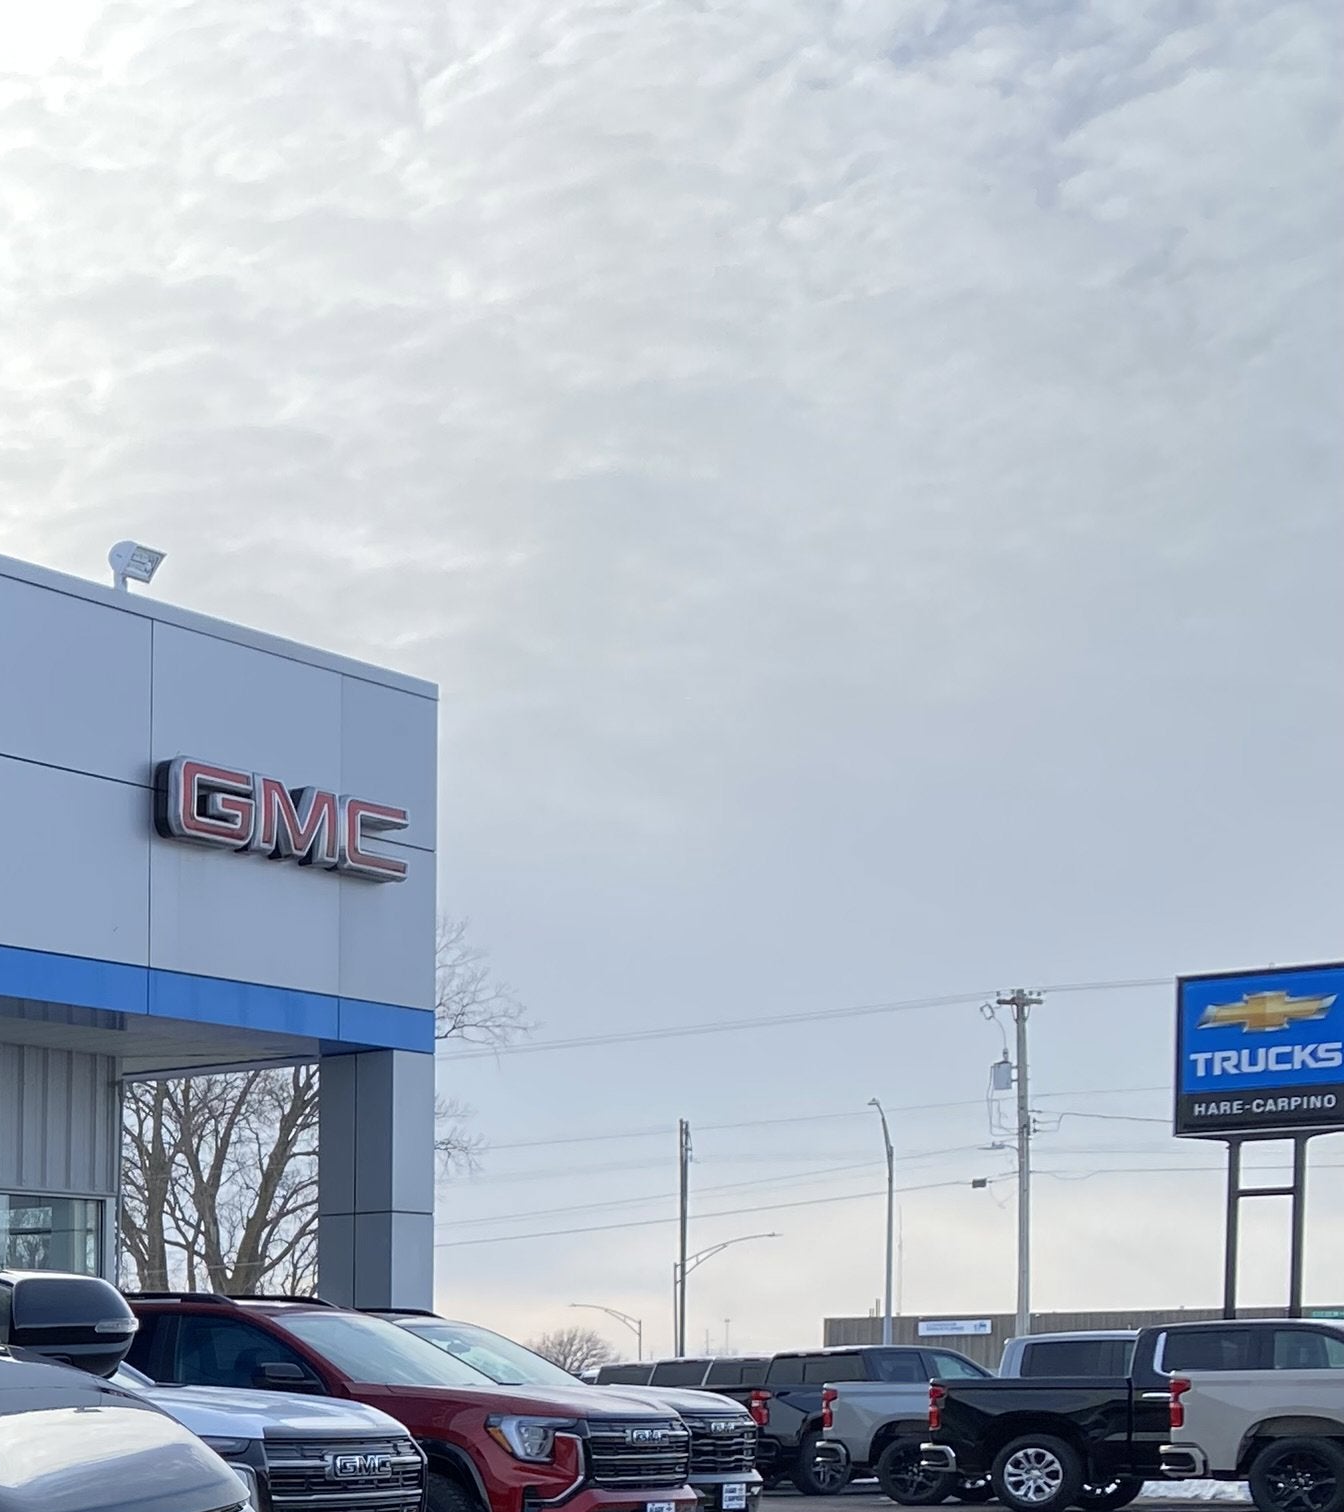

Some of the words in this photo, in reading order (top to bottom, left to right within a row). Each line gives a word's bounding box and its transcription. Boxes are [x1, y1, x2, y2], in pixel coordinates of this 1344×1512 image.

[154, 755, 409, 883] GMC
[1189, 1041, 1343, 1077] TRUCKS
[1194, 1094, 1337, 1116] HARE-CARPINO
[334, 1454, 392, 1480] GMC
